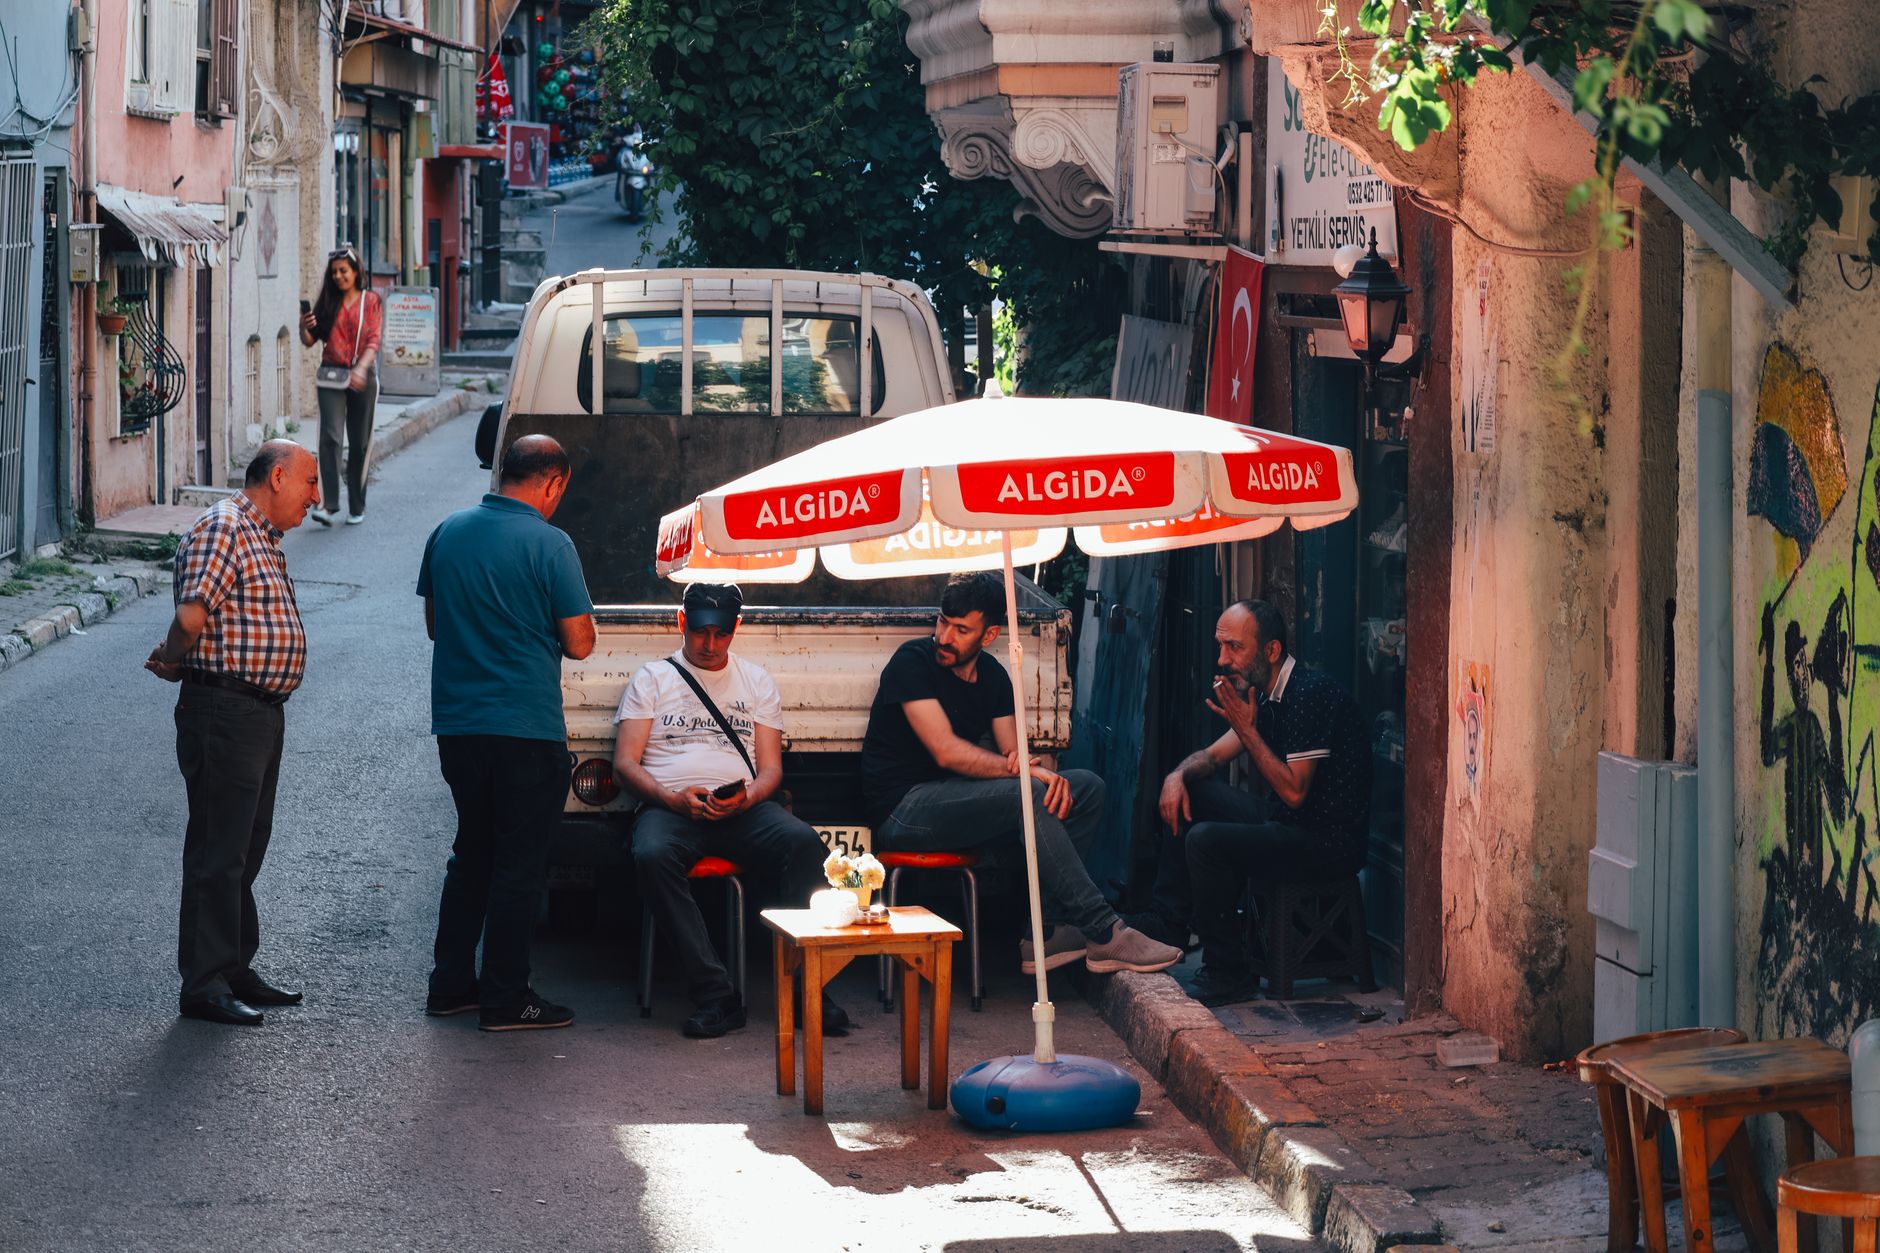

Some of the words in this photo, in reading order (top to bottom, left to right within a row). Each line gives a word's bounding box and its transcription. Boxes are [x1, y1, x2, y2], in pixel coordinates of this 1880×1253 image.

[1348, 182, 1362, 204] 0532
[1363, 181, 1374, 203] 425
[1375, 180, 1382, 202] 77
[1291, 209, 1327, 249] YETKİLİ
[1329, 209, 1366, 249] SERVİS
[661, 714, 689, 728] U.S.
[690, 716, 719, 733] Polo
